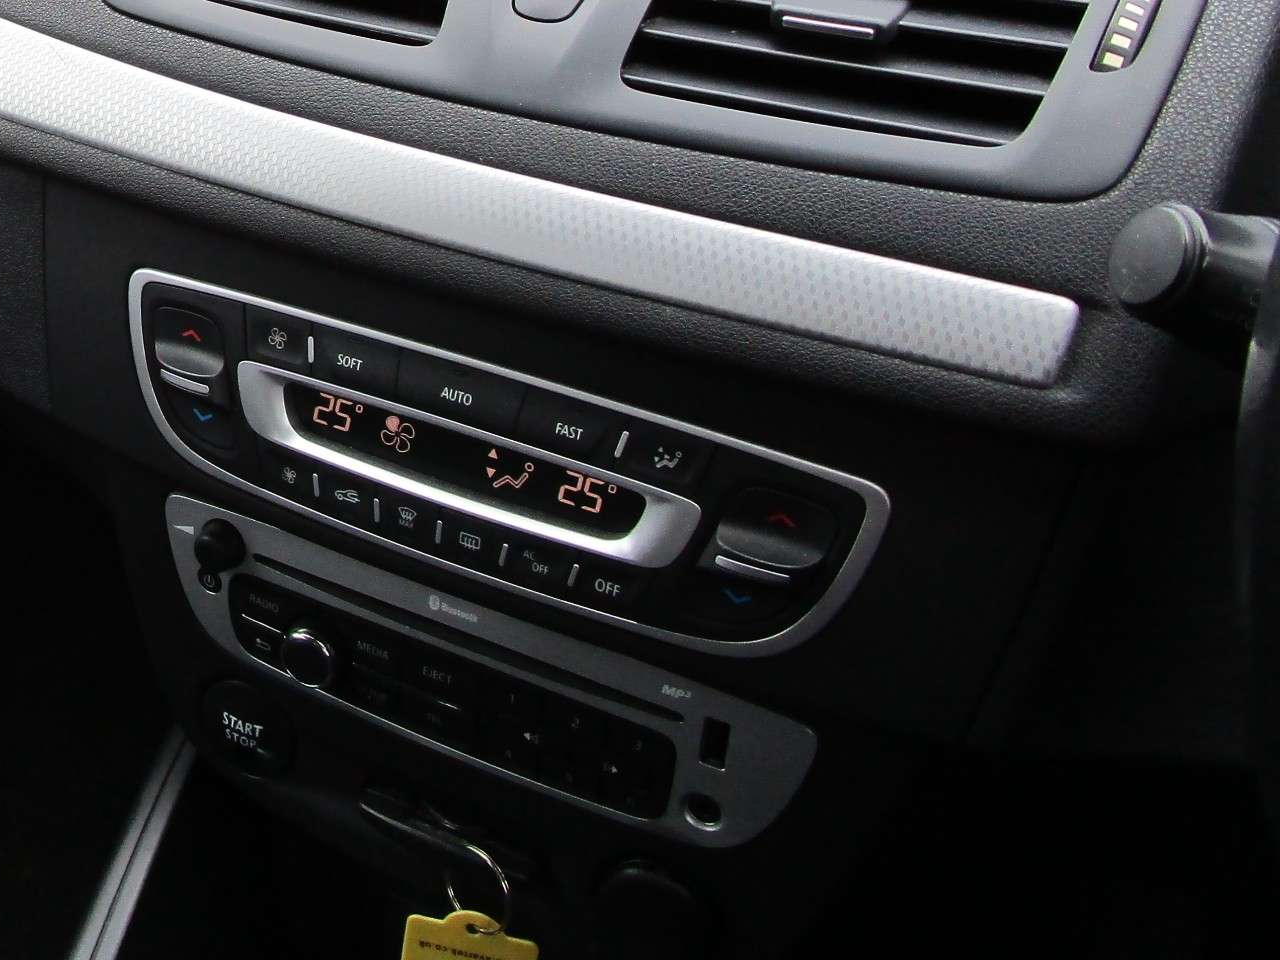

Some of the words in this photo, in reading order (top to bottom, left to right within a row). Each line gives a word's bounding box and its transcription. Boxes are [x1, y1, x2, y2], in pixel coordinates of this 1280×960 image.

[336, 353, 363, 372] SOFT
[440, 386, 473, 407] AUTO
[555, 422, 584, 441] FAST
[522, 549, 537, 560] AC
[531, 562, 550, 576] OFF
[594, 578, 622, 598] OFF
[248, 592, 280, 614] RADIO
[356, 639, 390, 661] MEDIA
[422, 664, 454, 685] EJECT
[221, 711, 263, 738] START
[223, 729, 256, 749] STOP
